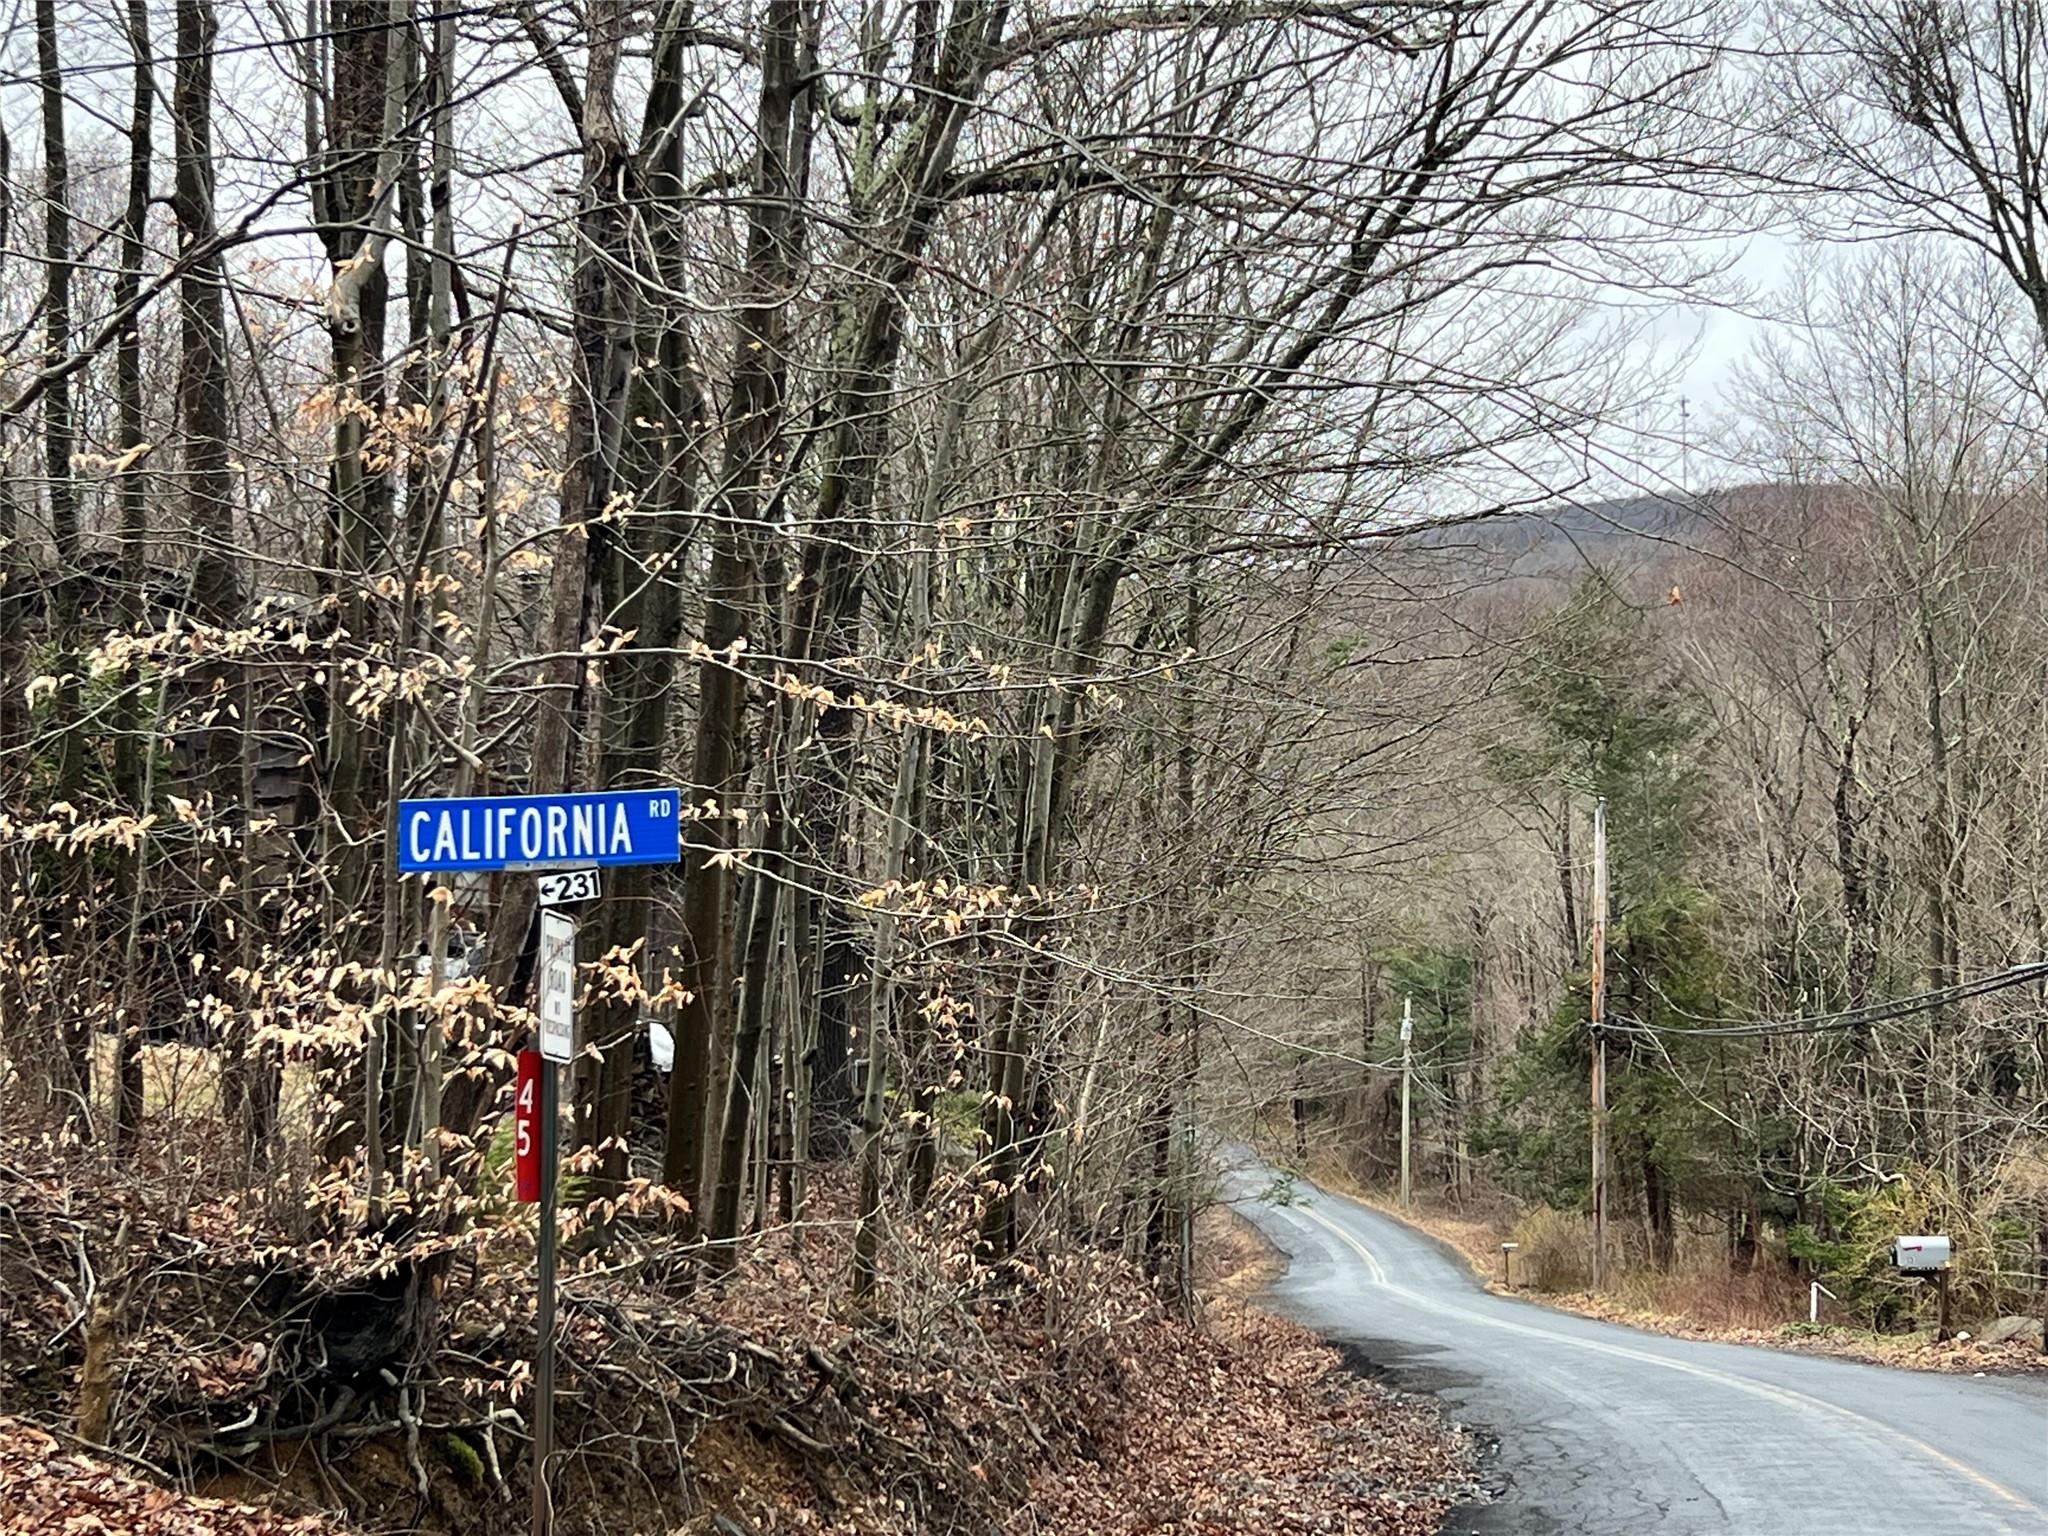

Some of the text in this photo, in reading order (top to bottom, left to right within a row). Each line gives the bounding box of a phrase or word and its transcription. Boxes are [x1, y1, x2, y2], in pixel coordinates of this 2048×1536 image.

[410, 799, 671, 862] CALIFORNIA RD
[555, 872, 601, 902] 231
